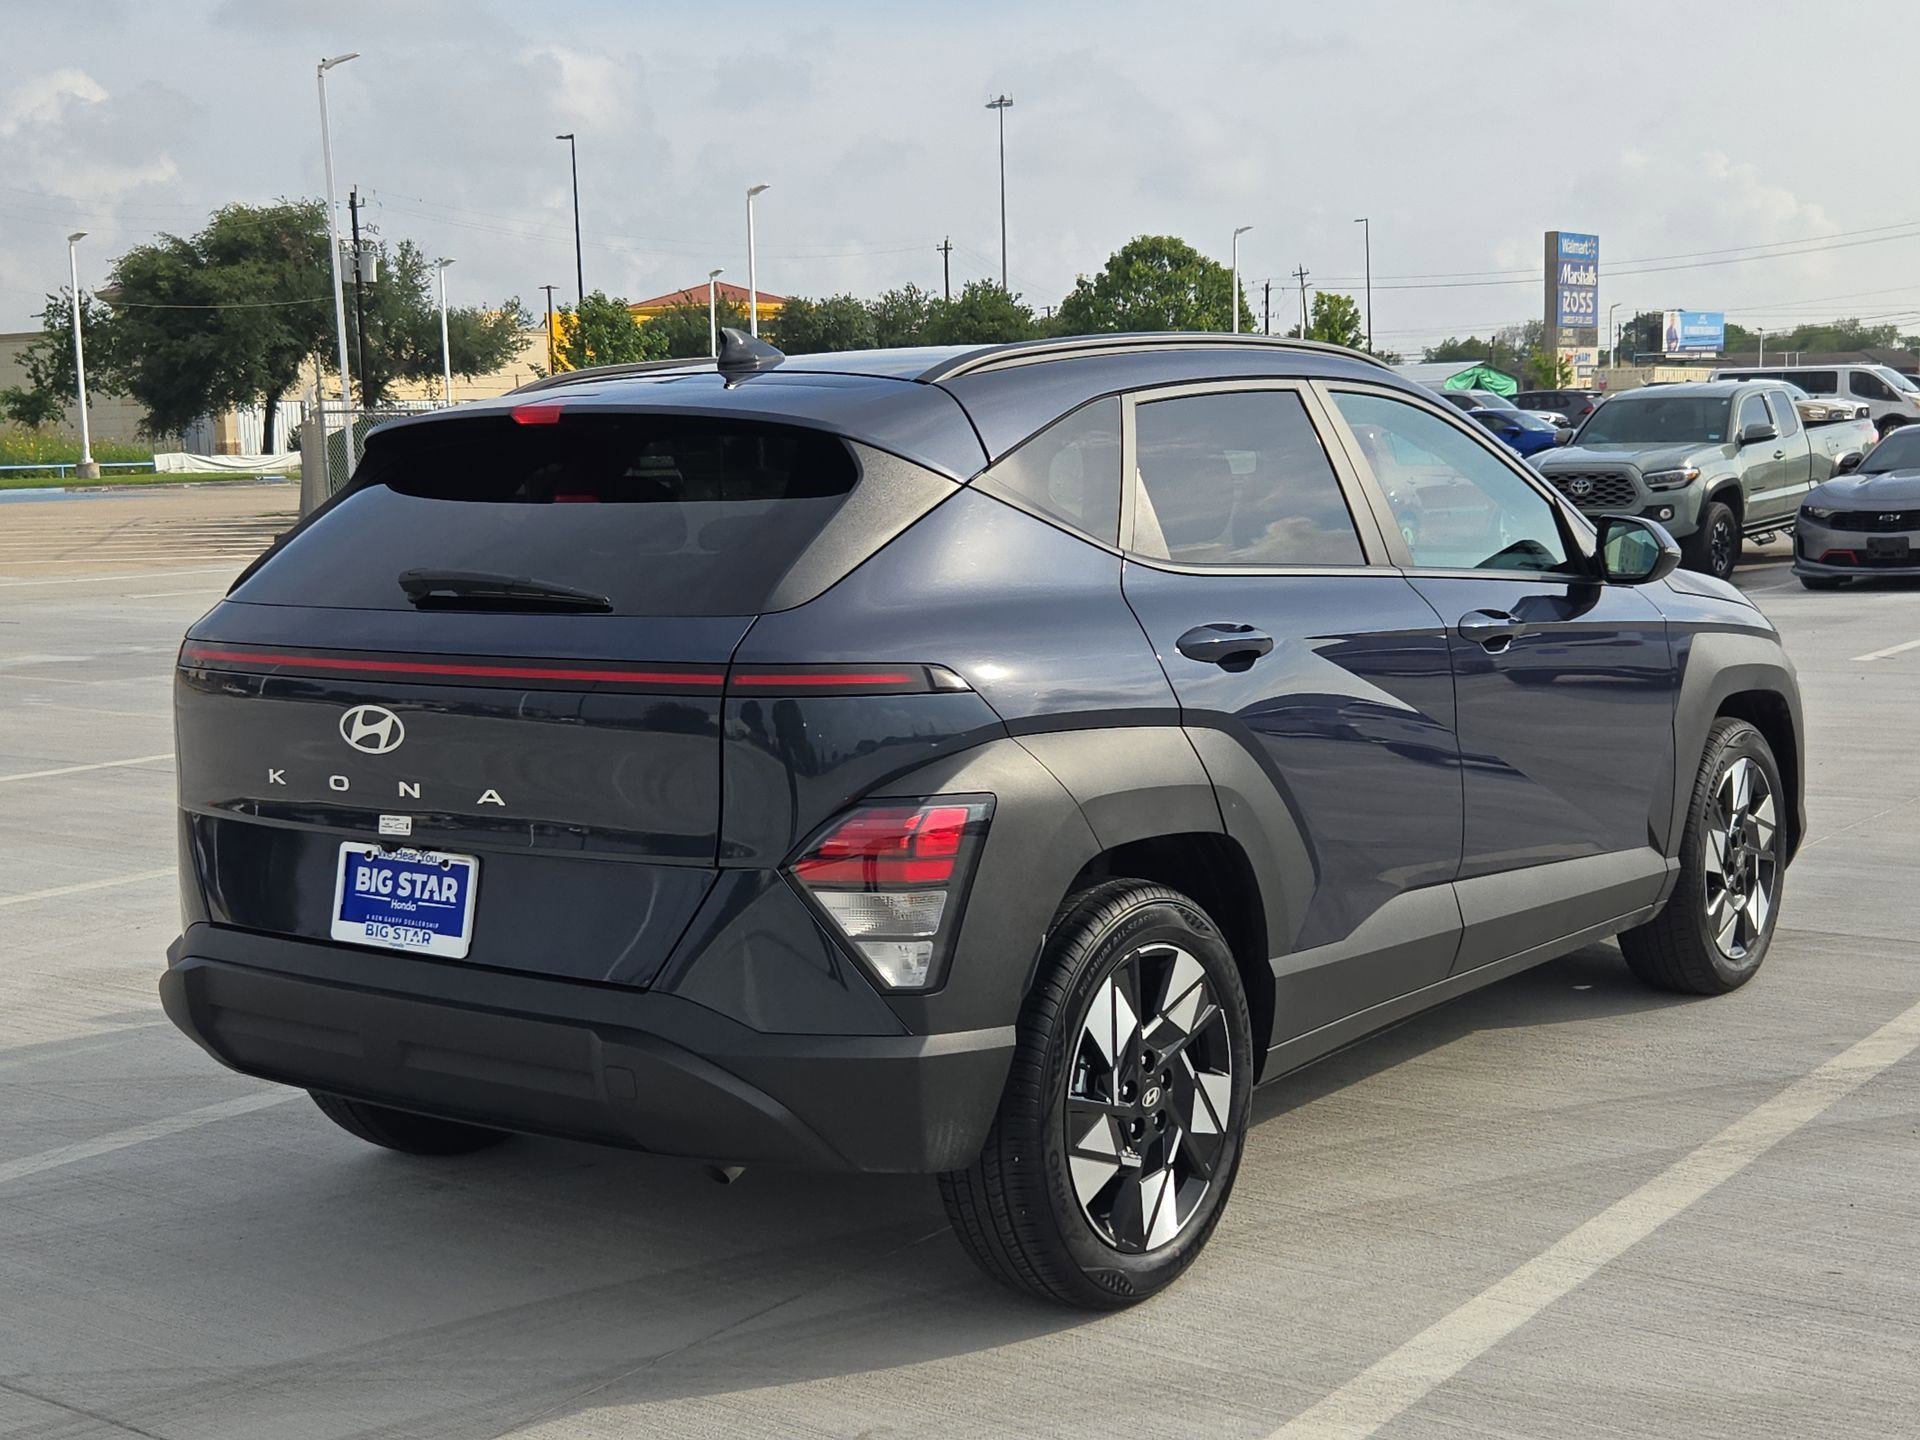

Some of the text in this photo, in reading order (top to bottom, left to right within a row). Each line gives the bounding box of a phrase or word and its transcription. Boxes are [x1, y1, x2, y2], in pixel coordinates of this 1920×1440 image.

[1562, 239, 1588, 255] Walmart
[1560, 263, 1597, 286] Marshalls
[1563, 291, 1593, 313] ROSS
[269, 768, 506, 806] KONA
[420, 850, 437, 864] You
[355, 866, 458, 903] BIG STAR
[390, 899, 416, 911] Honda
[365, 923, 431, 944] BIG STAR
